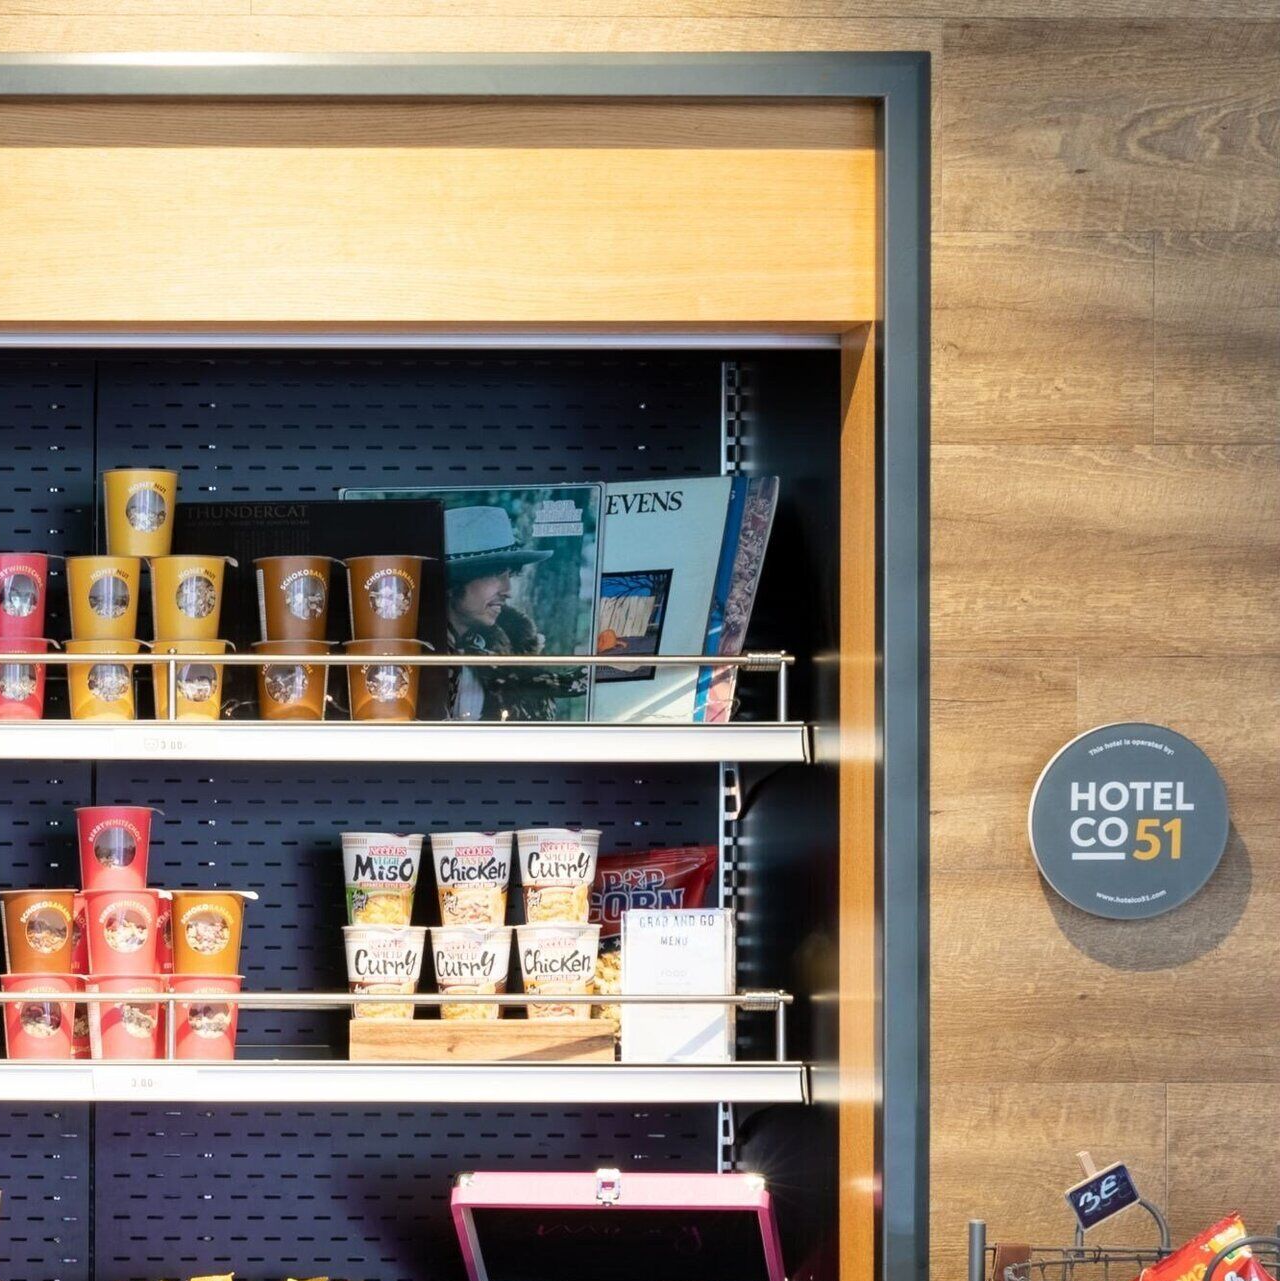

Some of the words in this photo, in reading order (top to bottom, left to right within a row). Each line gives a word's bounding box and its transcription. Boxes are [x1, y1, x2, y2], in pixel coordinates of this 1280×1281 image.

[605, 491, 683, 515] EVENS
[186, 505, 311, 519] THUNDERCAT
[1088, 745, 1104, 756] This
[1104, 740, 1122, 749] hotel
[1070, 781, 1195, 811] HOTEL
[639, 916, 668, 928] GRAB
[673, 915, 695, 927] AND
[700, 914, 714, 927] GO
[661, 936, 688, 946] MENU
